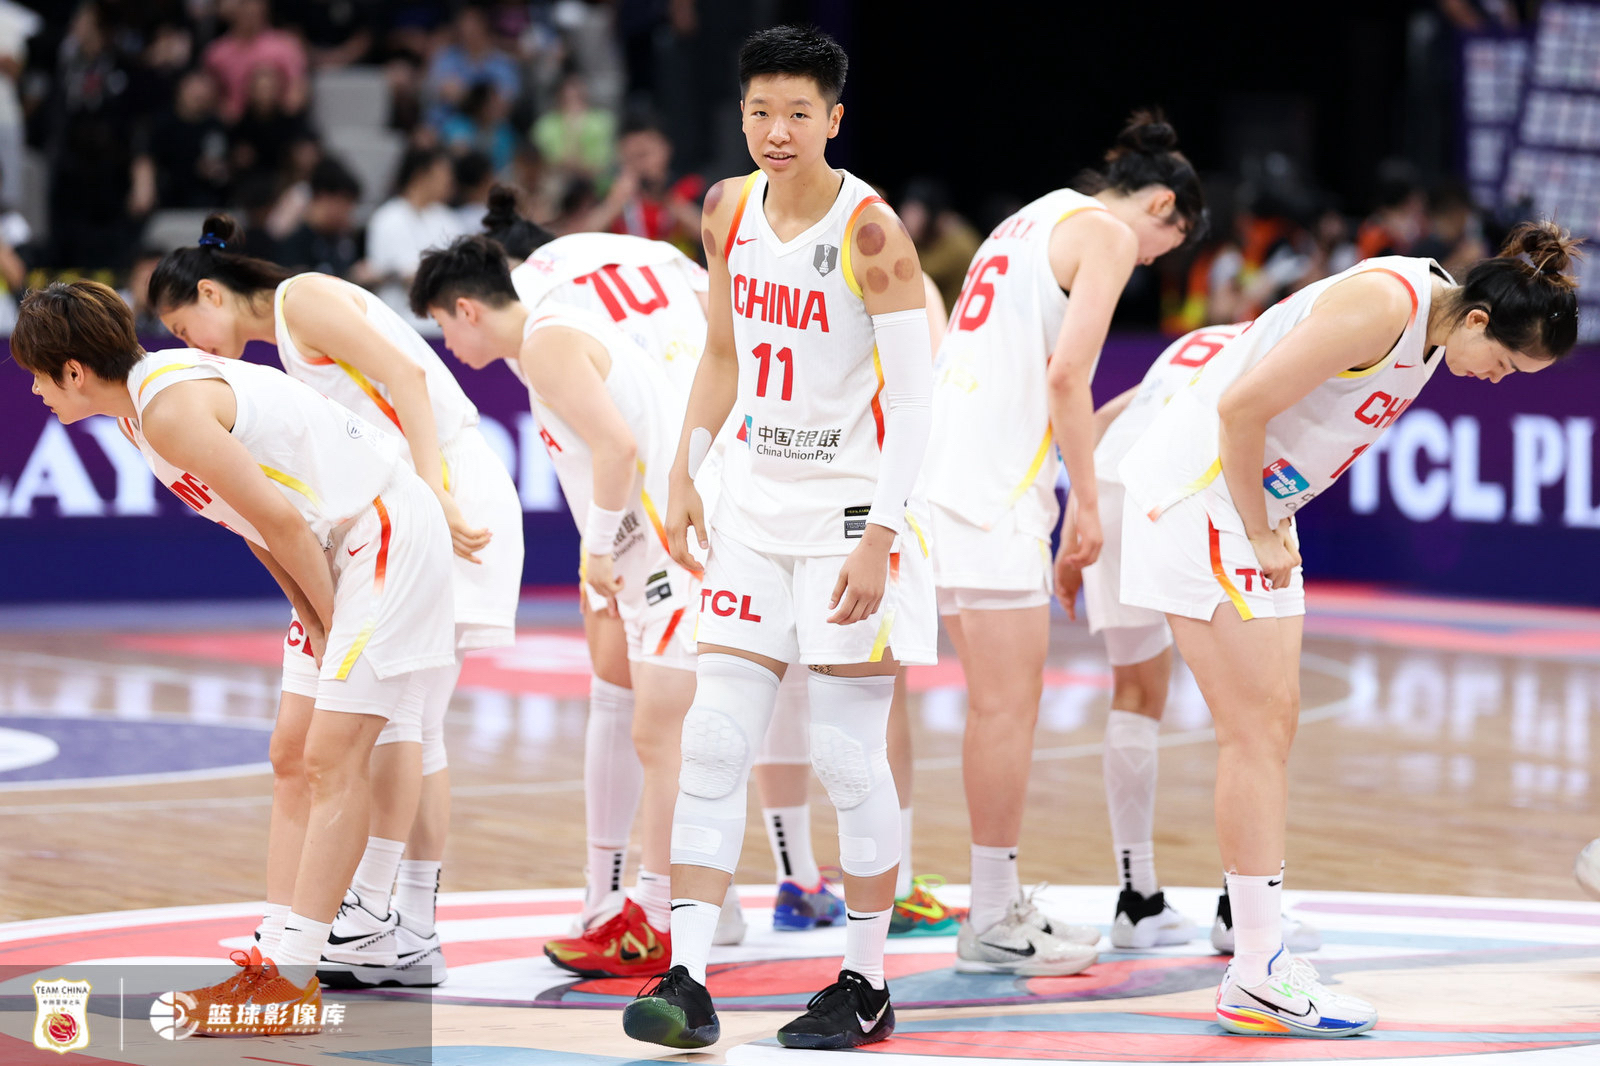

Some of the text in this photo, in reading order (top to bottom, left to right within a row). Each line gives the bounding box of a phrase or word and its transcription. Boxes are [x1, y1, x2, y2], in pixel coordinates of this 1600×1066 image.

[733, 273, 830, 333] CHINA
[751, 342, 794, 402] 11
[756, 444, 836, 464] China UnionPay
[758, 425, 842, 448] 中国银联
[1350, 408, 1507, 523] TCL
[0, 416, 163, 518] AY
[700, 588, 762, 623] TCL
